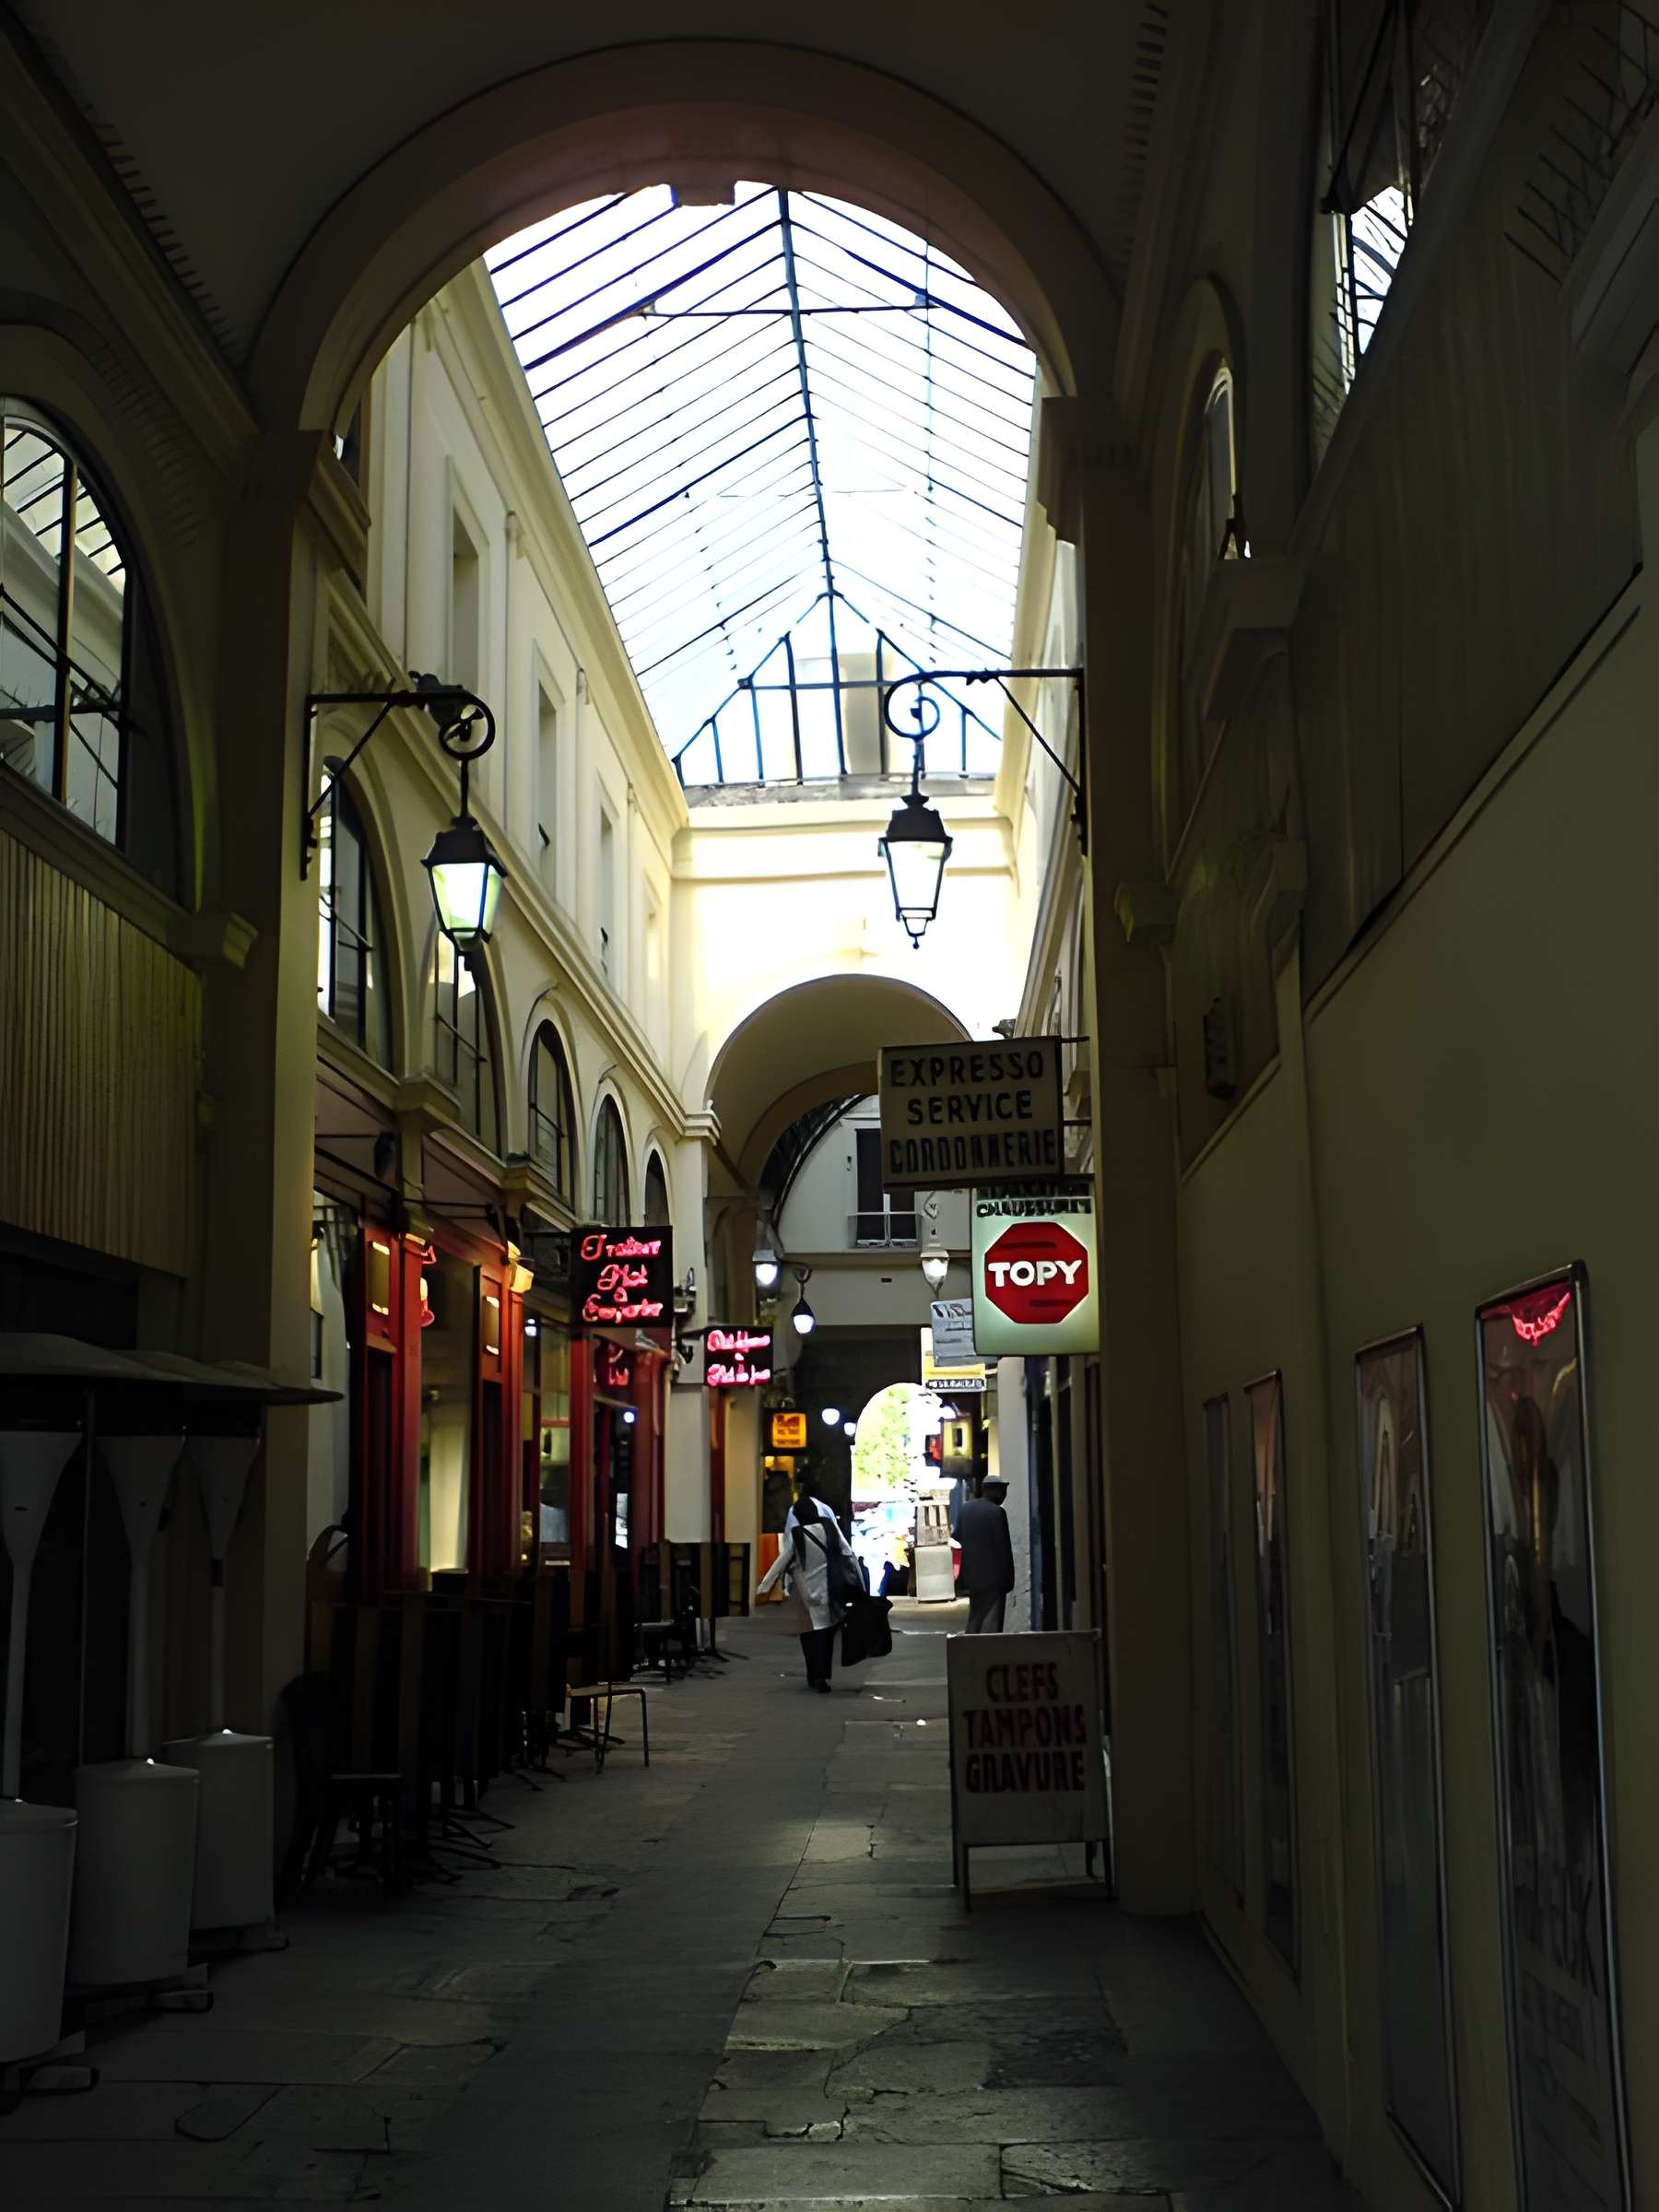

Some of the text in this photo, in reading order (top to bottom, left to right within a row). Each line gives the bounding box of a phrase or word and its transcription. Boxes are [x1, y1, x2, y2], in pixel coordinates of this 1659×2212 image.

[890, 1051, 1043, 1088] EXPRESSO
[907, 1090, 1033, 1125] SERVICE
[889, 1129, 1056, 1173] CORDONNERIE
[987, 1259, 1083, 1288] TOPY
[986, 1663, 1058, 1702] CLEFS
[963, 1705, 1086, 1748] TAMPONS
[966, 1751, 1085, 1793] GRAVURE
